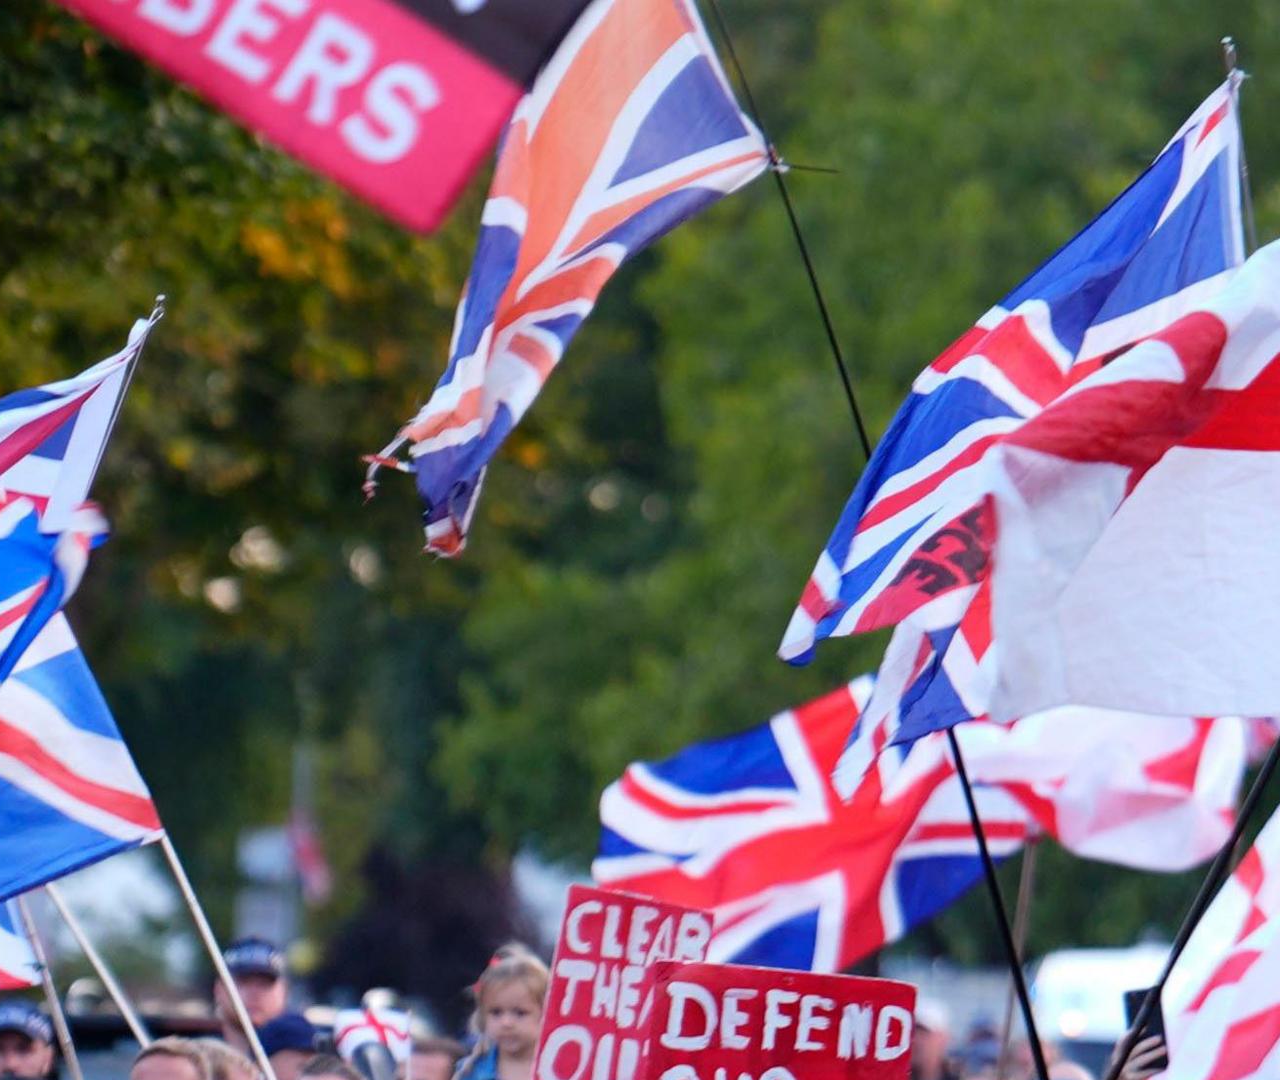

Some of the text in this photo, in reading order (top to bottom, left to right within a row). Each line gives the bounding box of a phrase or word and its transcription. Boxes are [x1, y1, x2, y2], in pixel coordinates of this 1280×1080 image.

[566, 900, 711, 968] CLEAR
[556, 958, 655, 1030] THE
[660, 981, 912, 1062] DEFEND
